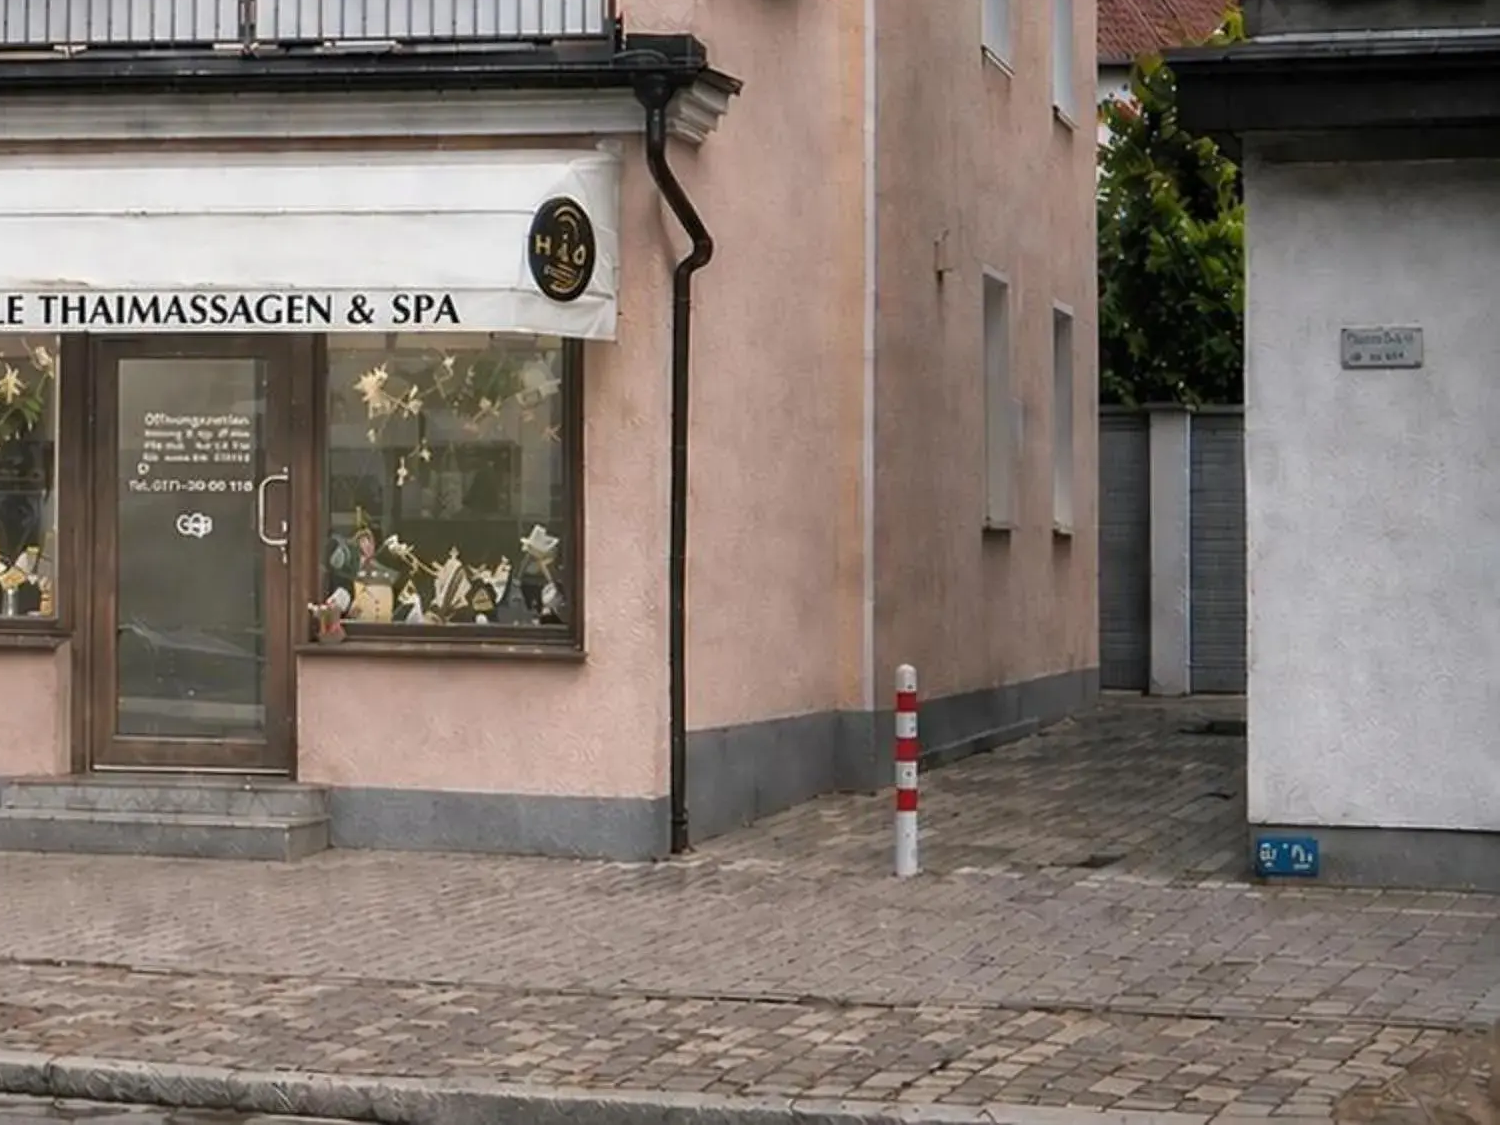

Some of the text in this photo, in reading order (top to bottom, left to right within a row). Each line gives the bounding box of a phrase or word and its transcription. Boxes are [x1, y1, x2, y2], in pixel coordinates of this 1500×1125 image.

[38, 294, 332, 324] THAIMASSAGEN
[347, 294, 374, 324] &
[392, 293, 460, 324] SPA
